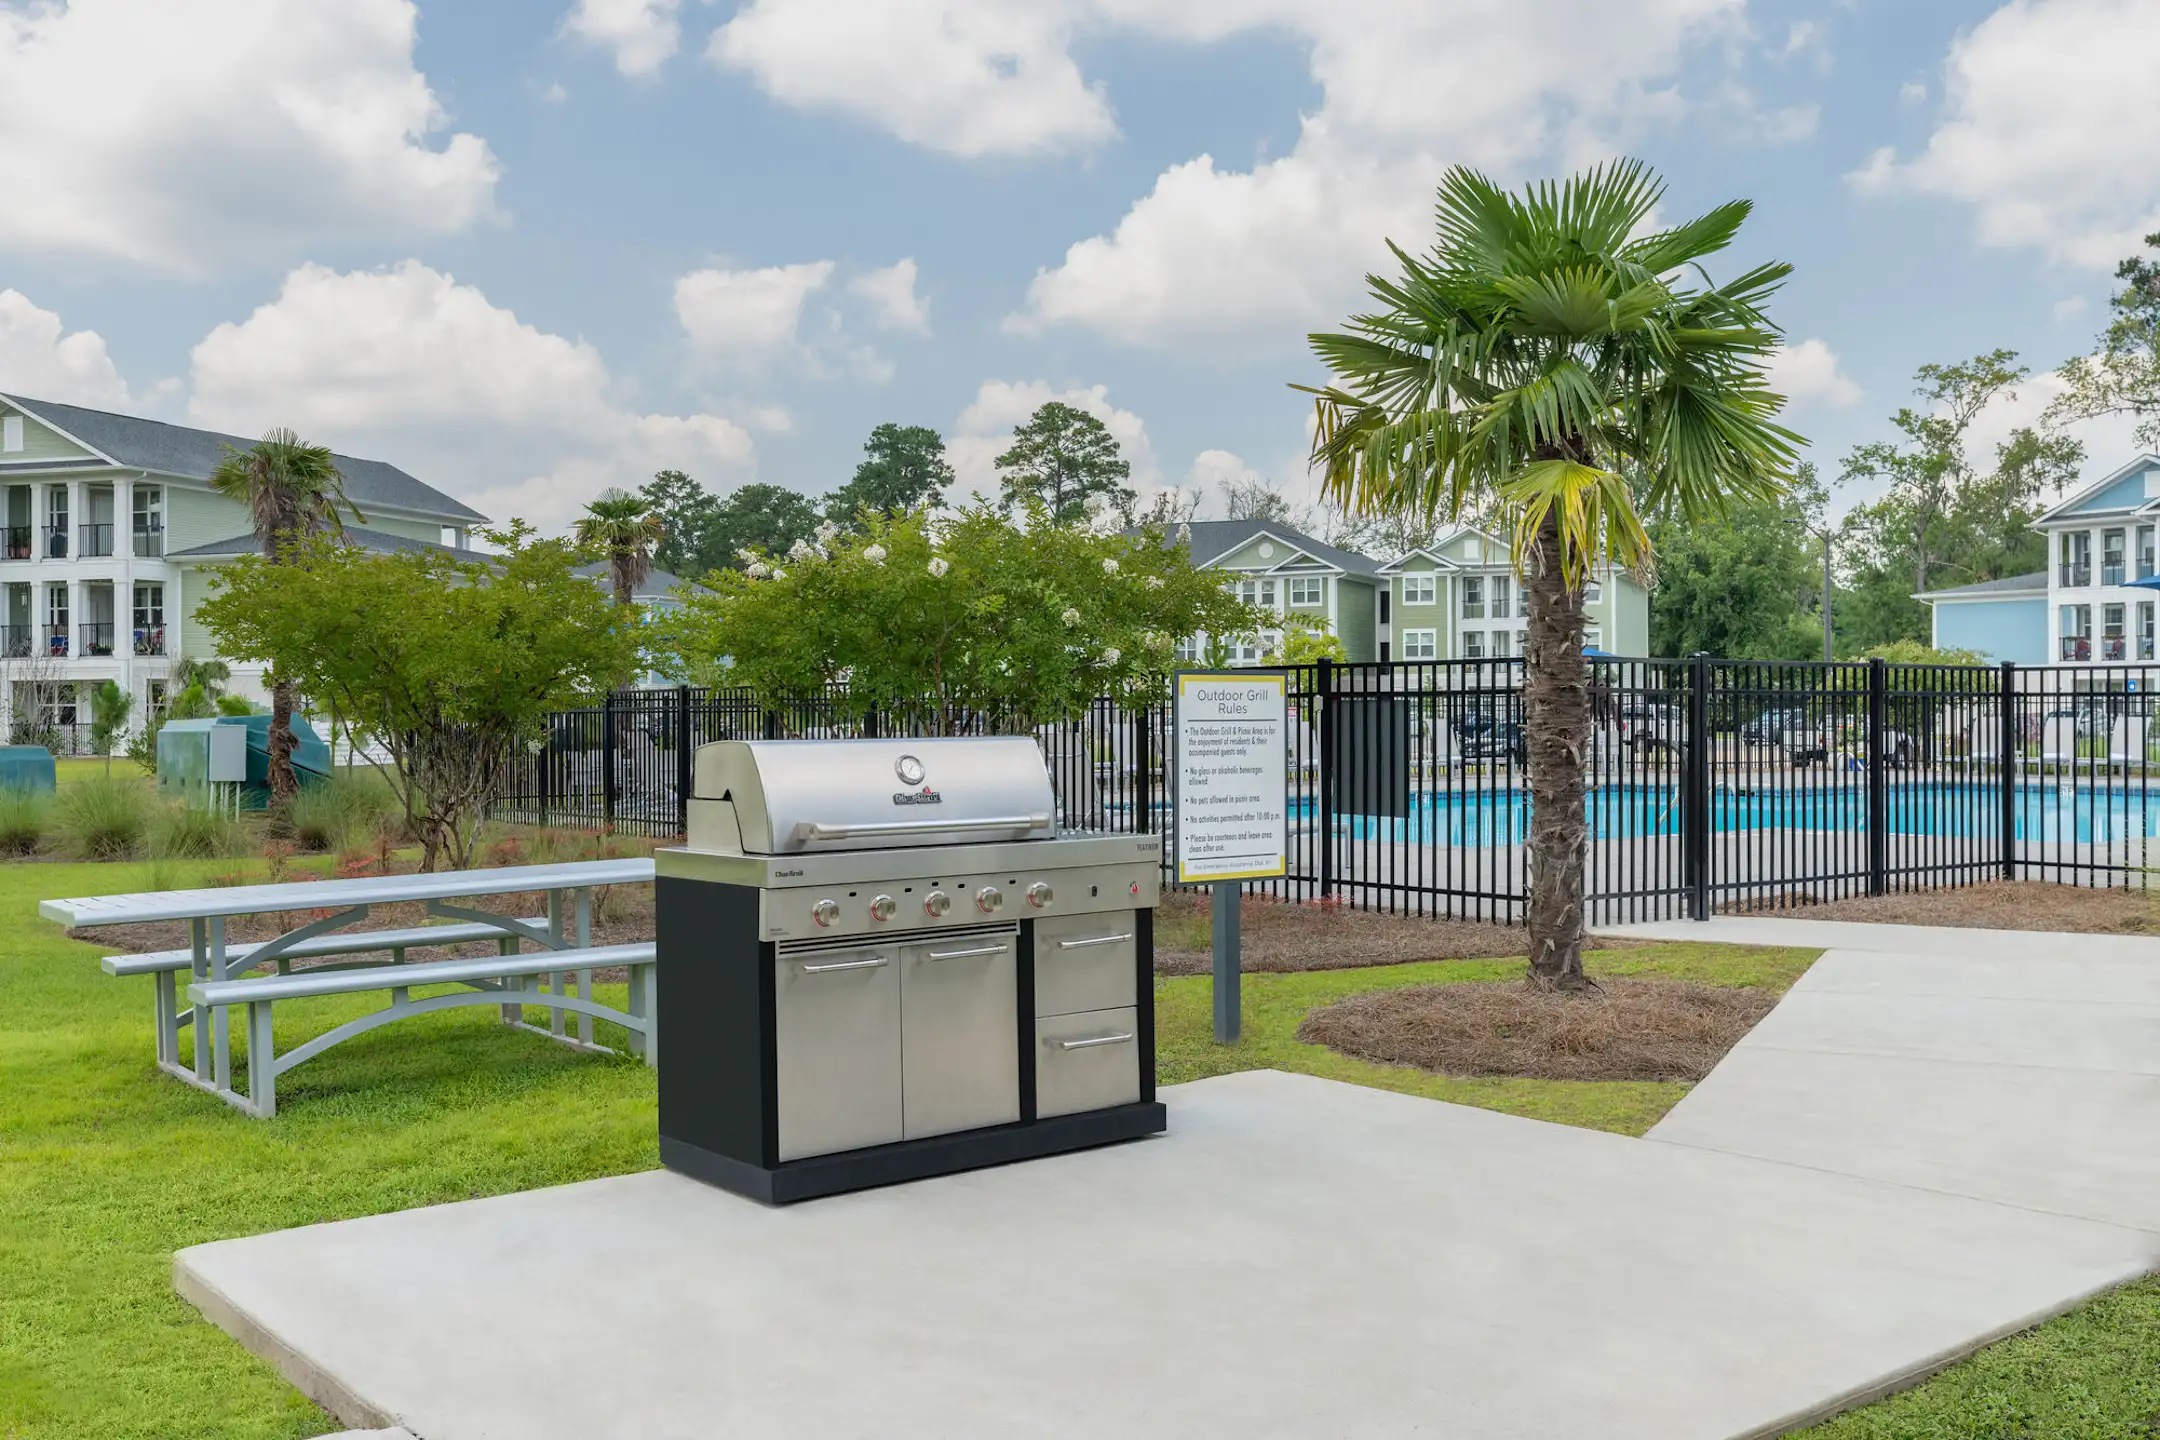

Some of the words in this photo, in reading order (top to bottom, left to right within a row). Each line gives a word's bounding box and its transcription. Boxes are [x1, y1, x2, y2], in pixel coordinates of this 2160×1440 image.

[1197, 689, 1243, 701] Outdoor
[1246, 689, 1268, 701] Grill
[1218, 702, 1248, 714] Rules
[1190, 726, 1199, 736] The
[1200, 726, 1219, 736] Outdoor
[1221, 726, 1231, 735] Grill
[1238, 726, 1251, 735] Picnic
[1252, 726, 1263, 735] Area
[1188, 737, 1196, 746] the
[1197, 738, 1223, 747] enjoyment
[1224, 736, 1229, 745] of
[1229, 737, 1251, 745] residents
[1251, 736, 1256, 745] &
[1256, 736, 1267, 745] their
[1188, 748, 1220, 757] accompanied
[1220, 748, 1236, 757] guests
[1190, 767, 1197, 775] No
[1198, 766, 1210, 777] glass
[1218, 766, 1238, 774] alcoholic
[1239, 766, 1263, 776] beverages
[1190, 796, 1197, 804] No
[1198, 796, 1208, 806] pets
[1209, 794, 1228, 804] allowed
[1229, 794, 1234, 803] in
[1235, 794, 1247, 804] picnic
[1190, 815, 1197, 823] No
[1199, 814, 1219, 823] activities
[1220, 813, 1243, 823] permitted
[1244, 812, 1255, 820] after
[1190, 834, 1206, 842] Please
[1207, 833, 1214, 841] be
[1215, 833, 1237, 842] courteous
[1238, 831, 1247, 840] and
[1248, 831, 1260, 839] leave
[1188, 845, 1202, 853] clean
[1203, 844, 1214, 852] after
